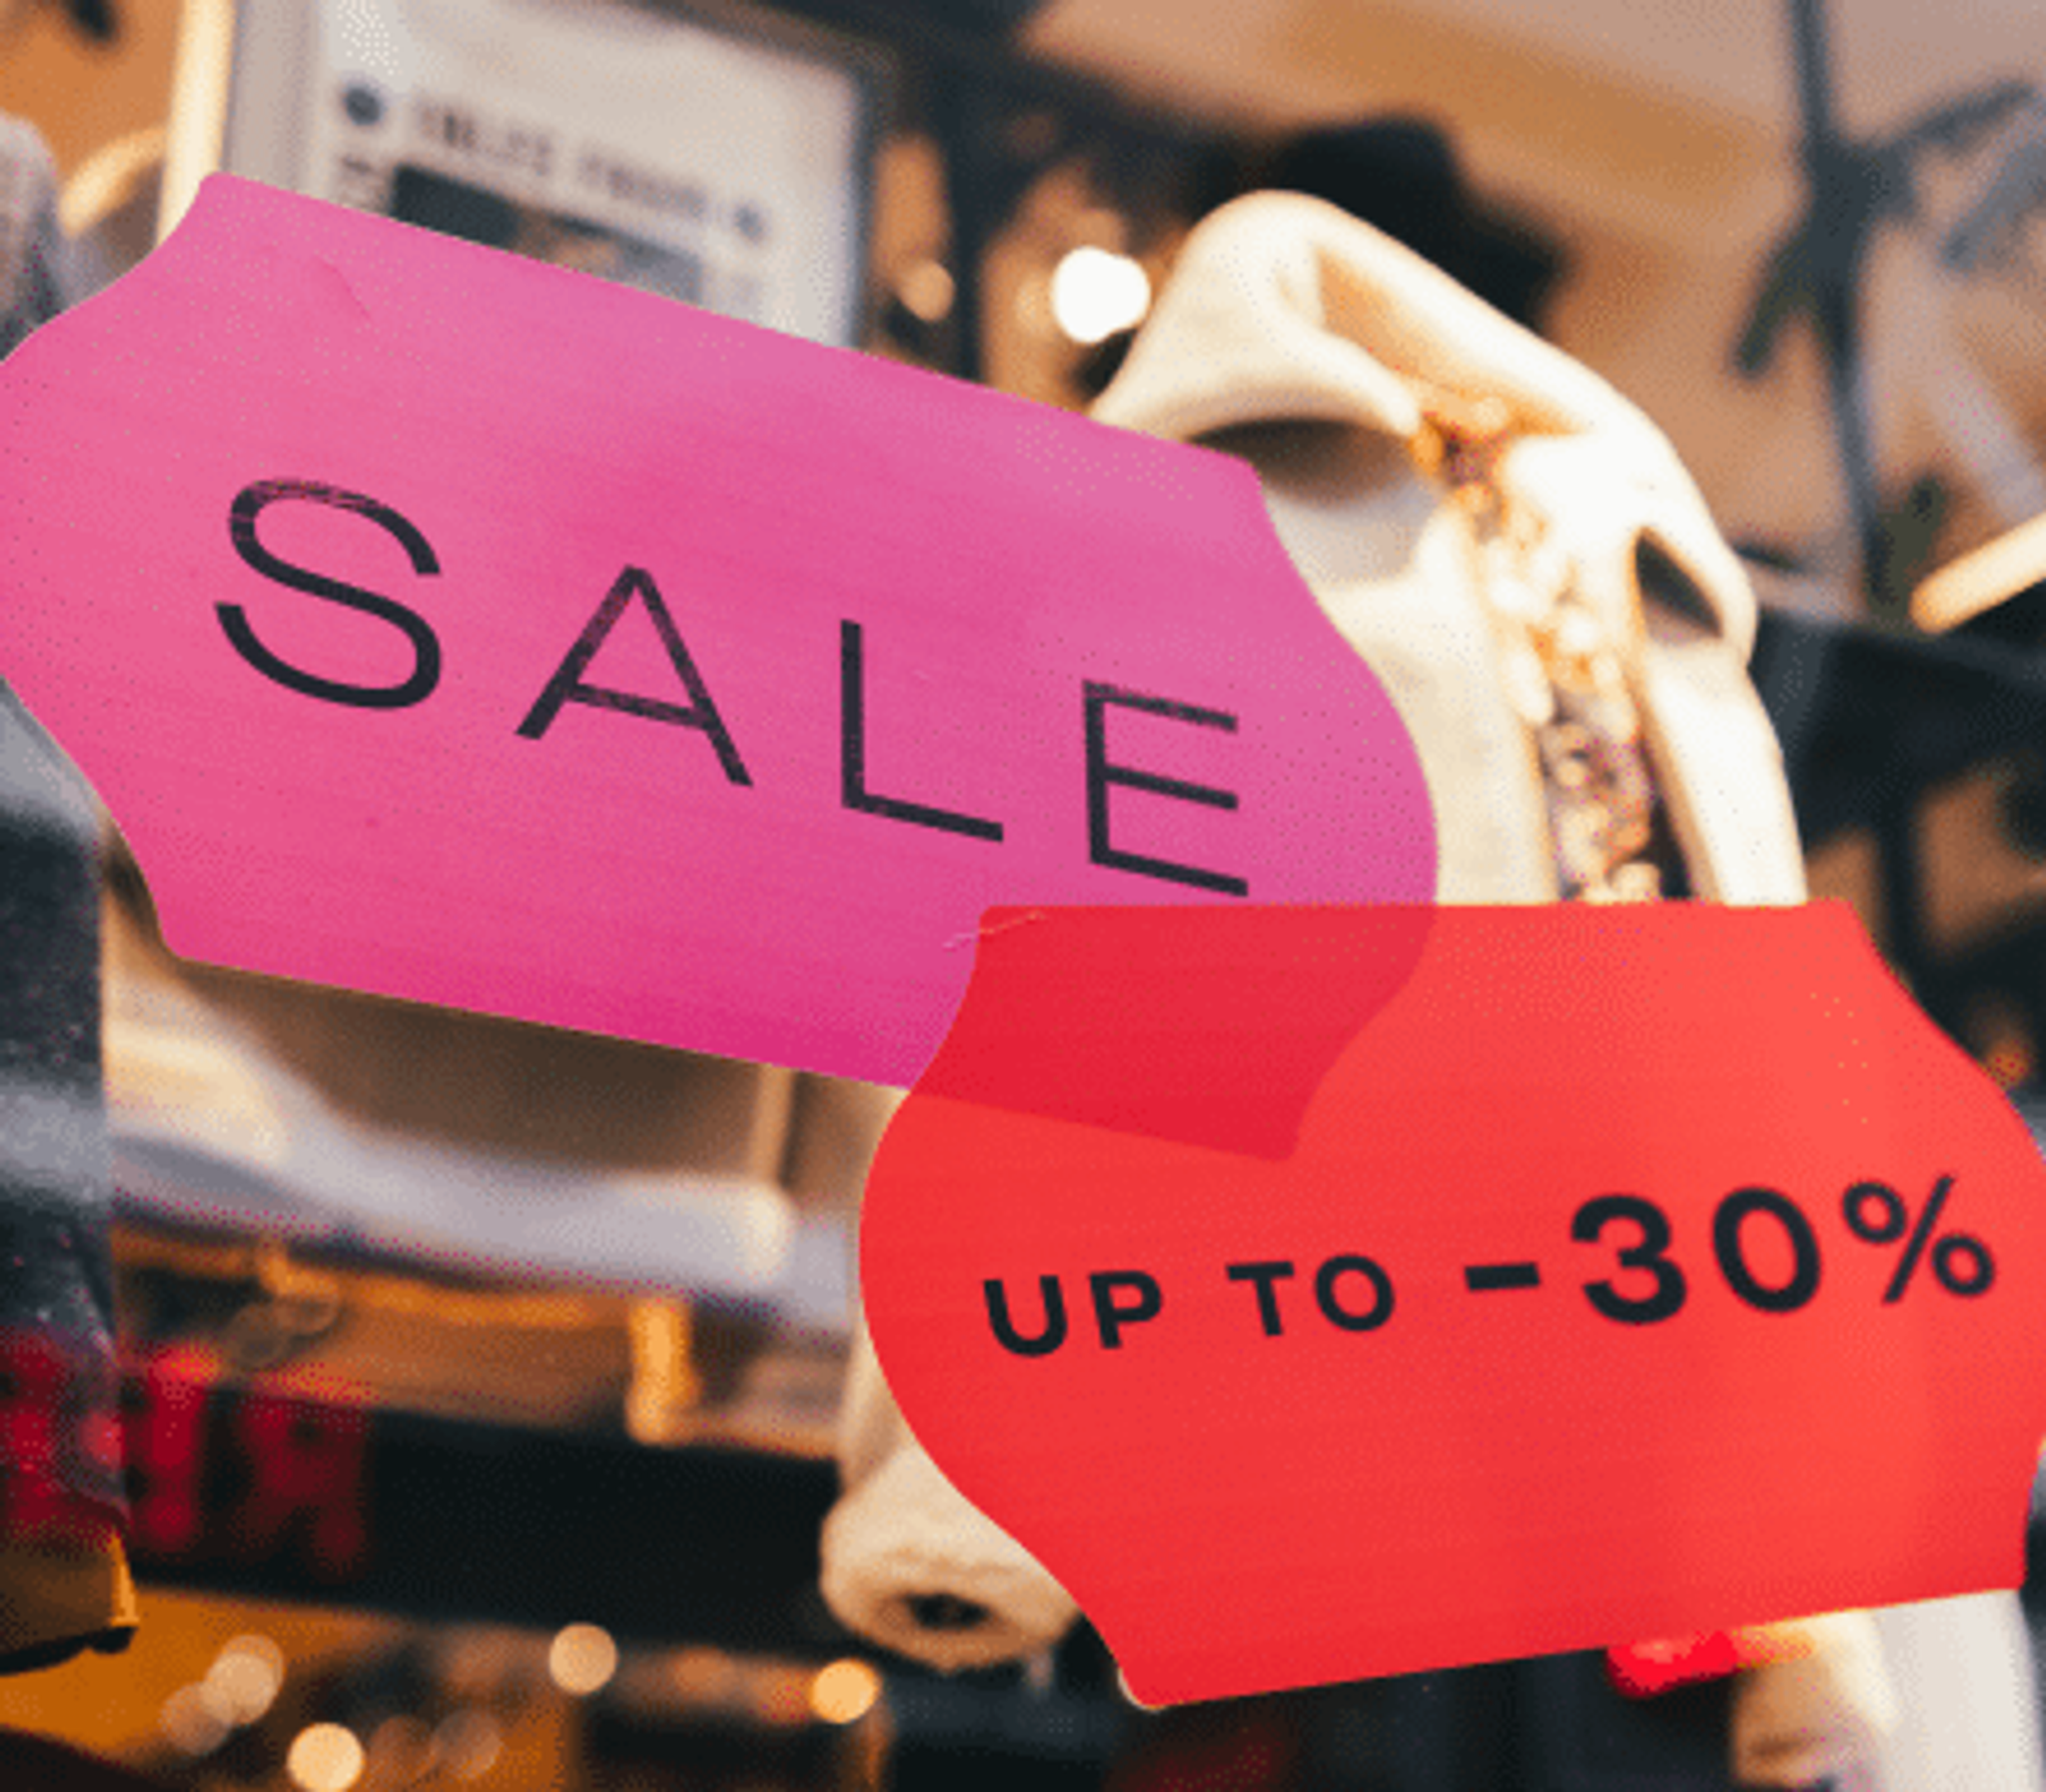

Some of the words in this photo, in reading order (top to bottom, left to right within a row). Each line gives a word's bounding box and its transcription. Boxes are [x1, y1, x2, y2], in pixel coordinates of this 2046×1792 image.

[214, 477, 1249, 897] SALE
[982, 1270, 1163, 1357] UP
[1227, 1254, 1396, 1337] TO
[1464, 1175, 1995, 1327] -30%
